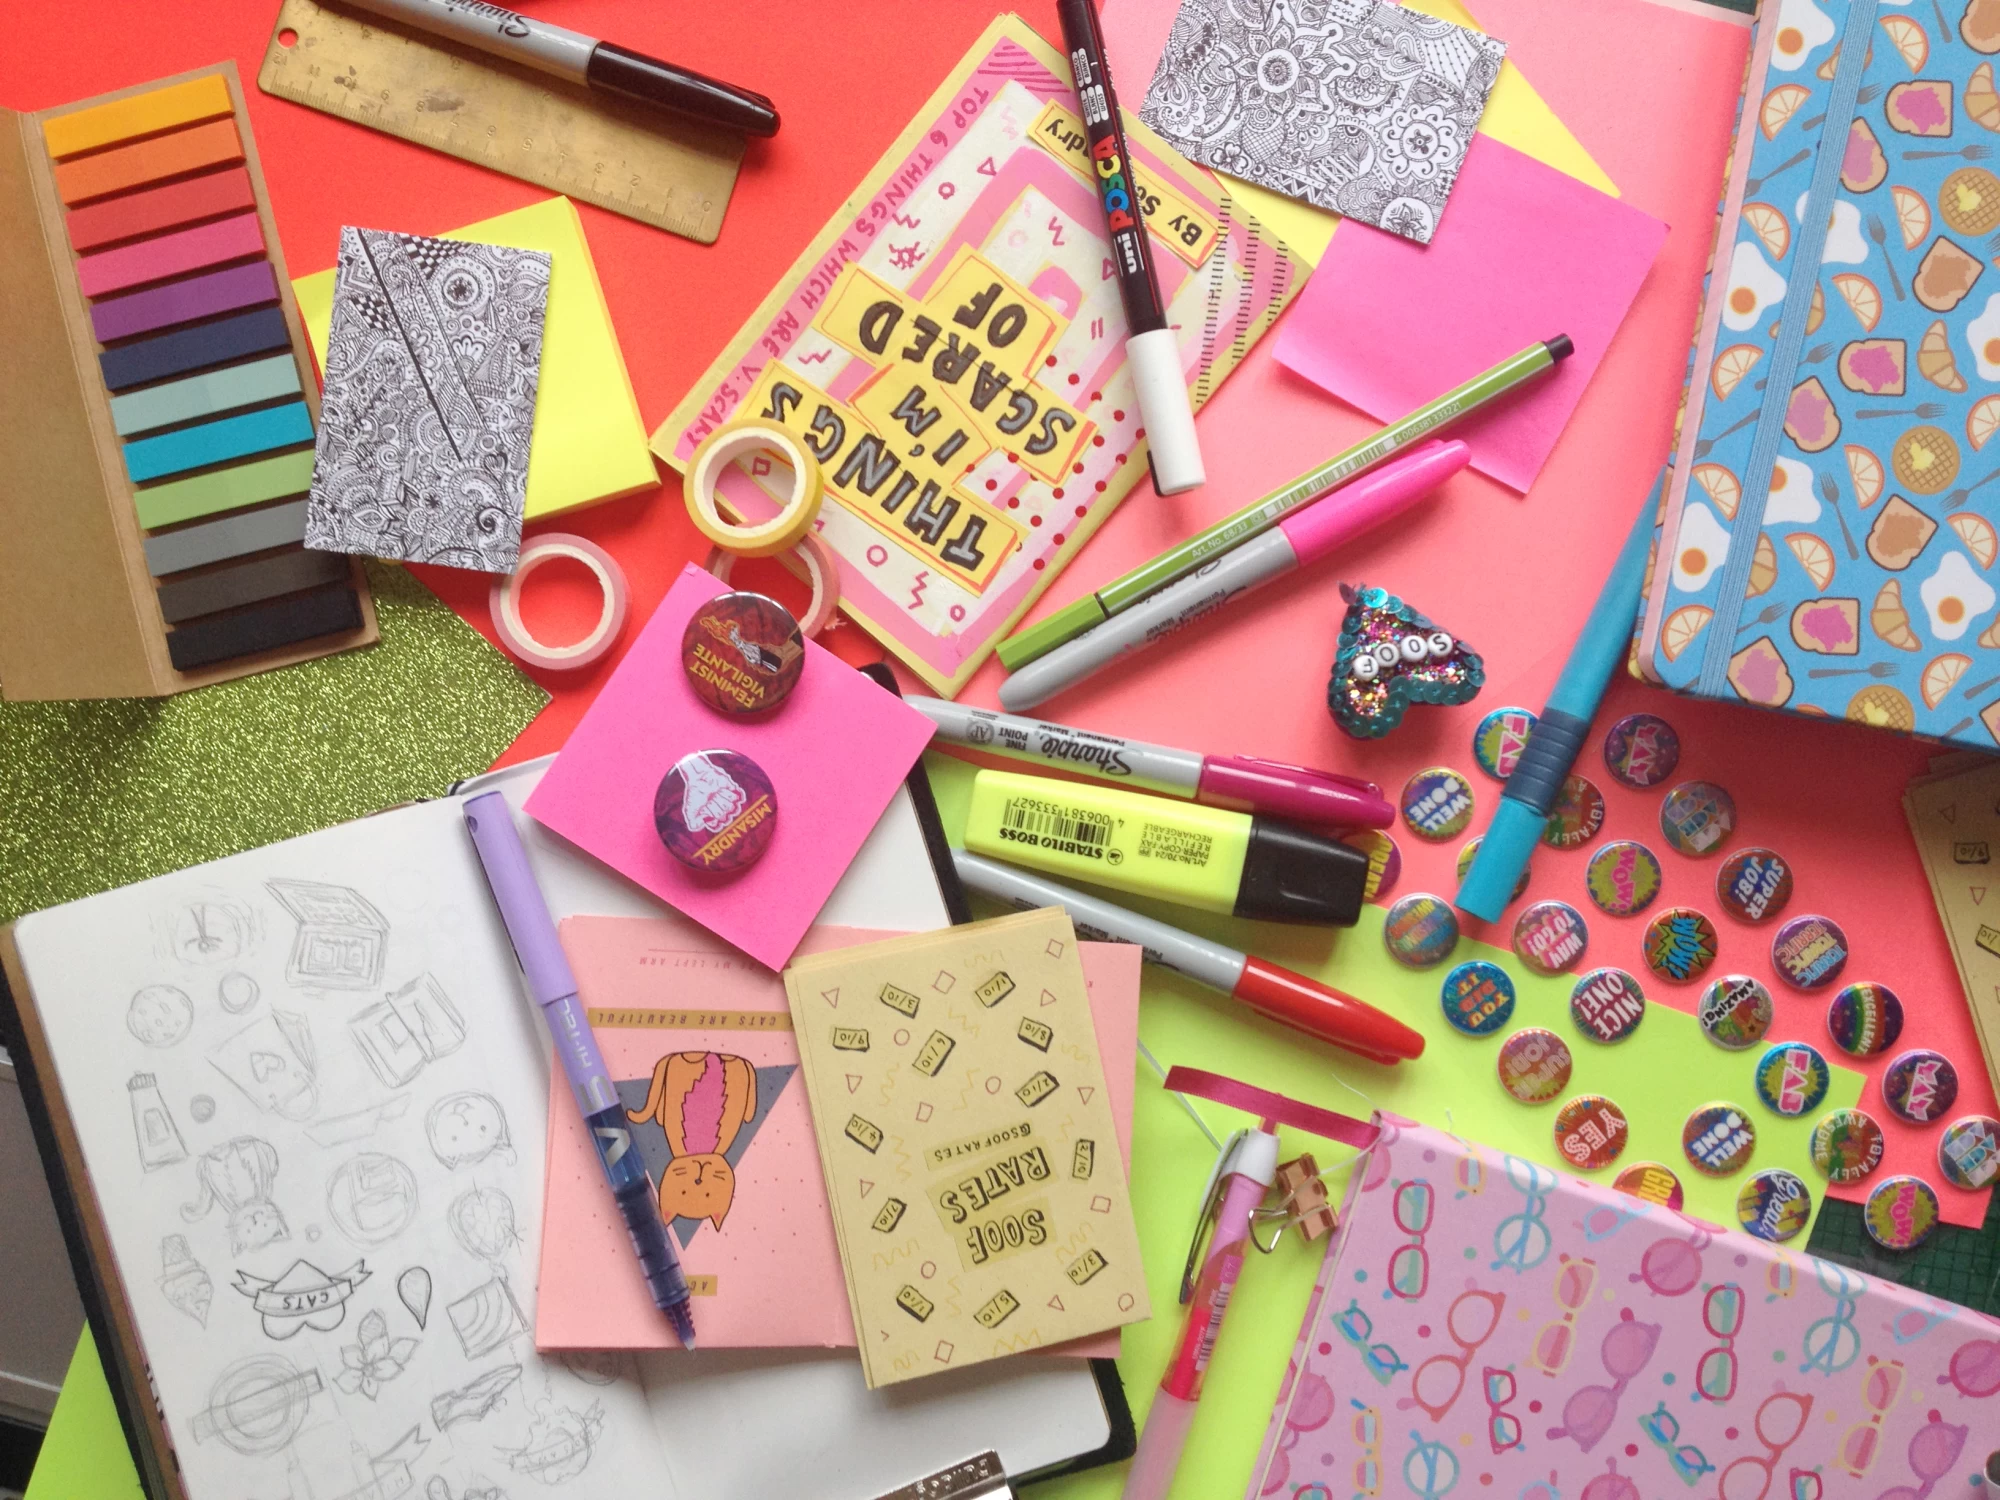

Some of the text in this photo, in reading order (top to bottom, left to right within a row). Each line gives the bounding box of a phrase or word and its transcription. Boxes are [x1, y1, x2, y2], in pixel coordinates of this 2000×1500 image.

[1092, 134, 1134, 233] POSCA
[1167, 214, 1203, 247] By
[686, 87, 989, 450] TOP 6 THINGS WHICH ARE V. SCARY
[1117, 231, 1137, 274] uni
[953, 282, 1028, 349] OF
[858, 299, 1077, 457] SCARED
[890, 384, 970, 467] I'M
[760, 380, 988, 572] THINGS
[1207, 535, 1224, 551] No.
[1223, 520, 1249, 541] 68/33
[693, 643, 765, 700] VIGILANTE
[1362, 635, 1448, 675] SOOF
[689, 659, 756, 709] FEMINIST
[998, 726, 1029, 742] POINT
[1005, 738, 1027, 751] FINE
[1038, 723, 1126, 747] Permanent Marker
[1496, 714, 1530, 778] FAB
[1626, 723, 1665, 786] YAY
[1039, 735, 1133, 777] Sharpie
[1012, 796, 1059, 815] 333627
[1063, 806, 1111, 827] 006381
[1408, 776, 1460, 822] DONE
[1422, 794, 1472, 832] WELL
[702, 801, 772, 866] MISANDRY
[999, 826, 1104, 860] STABILO BOSS
[1142, 831, 1212, 850] REFILLABLE
[1143, 823, 1213, 843] RECHARGEABLE
[1550, 798, 1604, 846] TOTALLY
[1611, 848, 1638, 911] WOW!
[1734, 855, 1764, 905] JOB!
[1744, 857, 1785, 921] SUPER
[1526, 909, 1578, 957] TO GO!
[1547, 932, 1585, 970] WAY
[1660, 916, 1701, 981] WOW!
[1775, 920, 1828, 963] TERRIFIC
[639, 955, 667, 967] ARM
[674, 957, 706, 969] LEFT
[1786, 933, 1838, 977] TERRIFIC
[1796, 944, 1848, 988] TERRIFIC
[887, 990, 916, 1009] 3/10
[983, 978, 1007, 997] 1/10
[1456, 972, 1481, 997] IT
[1458, 979, 1498, 1013] DID
[1574, 972, 1624, 1021] ONE!
[1701, 978, 1755, 1029] AMAZING!
[598, 1012, 687, 1025] BEAUTIFUL
[699, 1014, 728, 1026] ARE
[738, 1015, 777, 1027] CATS
[1467, 991, 1511, 1029] YOU
[1593, 991, 1643, 1041] NICE
[1856, 987, 1878, 1056] EXCELLENT
[839, 1032, 866, 1046] 9/10
[921, 1036, 947, 1069] 6/10
[1025, 1023, 1047, 1041] 8/10
[1504, 1035, 1551, 1077] JOB!
[1512, 1045, 1571, 1099] SUPER
[1022, 1079, 1052, 1097] 2/10
[1778, 1049, 1811, 1115] FAB
[1905, 1059, 1944, 1122] YAY
[851, 1120, 878, 1142] 4/10
[1563, 1107, 1627, 1163] YES
[1691, 1112, 1743, 1158] DONE
[1705, 1129, 1754, 1168] WELL
[1815, 1114, 1868, 1162] AWESOME
[1076, 1144, 1089, 1174] 2/10
[1829, 1133, 1883, 1182] TOTALLY
[939, 1146, 1051, 1224] RATES
[879, 1203, 899, 1226] 7/10
[1757, 1172, 1802, 1242] Great!
[1889, 1183, 1918, 1246] WOW!
[966, 1208, 1048, 1265] SOOF
[1070, 1254, 1097, 1277] 3/10
[282, 1291, 329, 1311] CATS
[903, 1291, 925, 1312] 1/10
[982, 1293, 1011, 1321] 5/10
